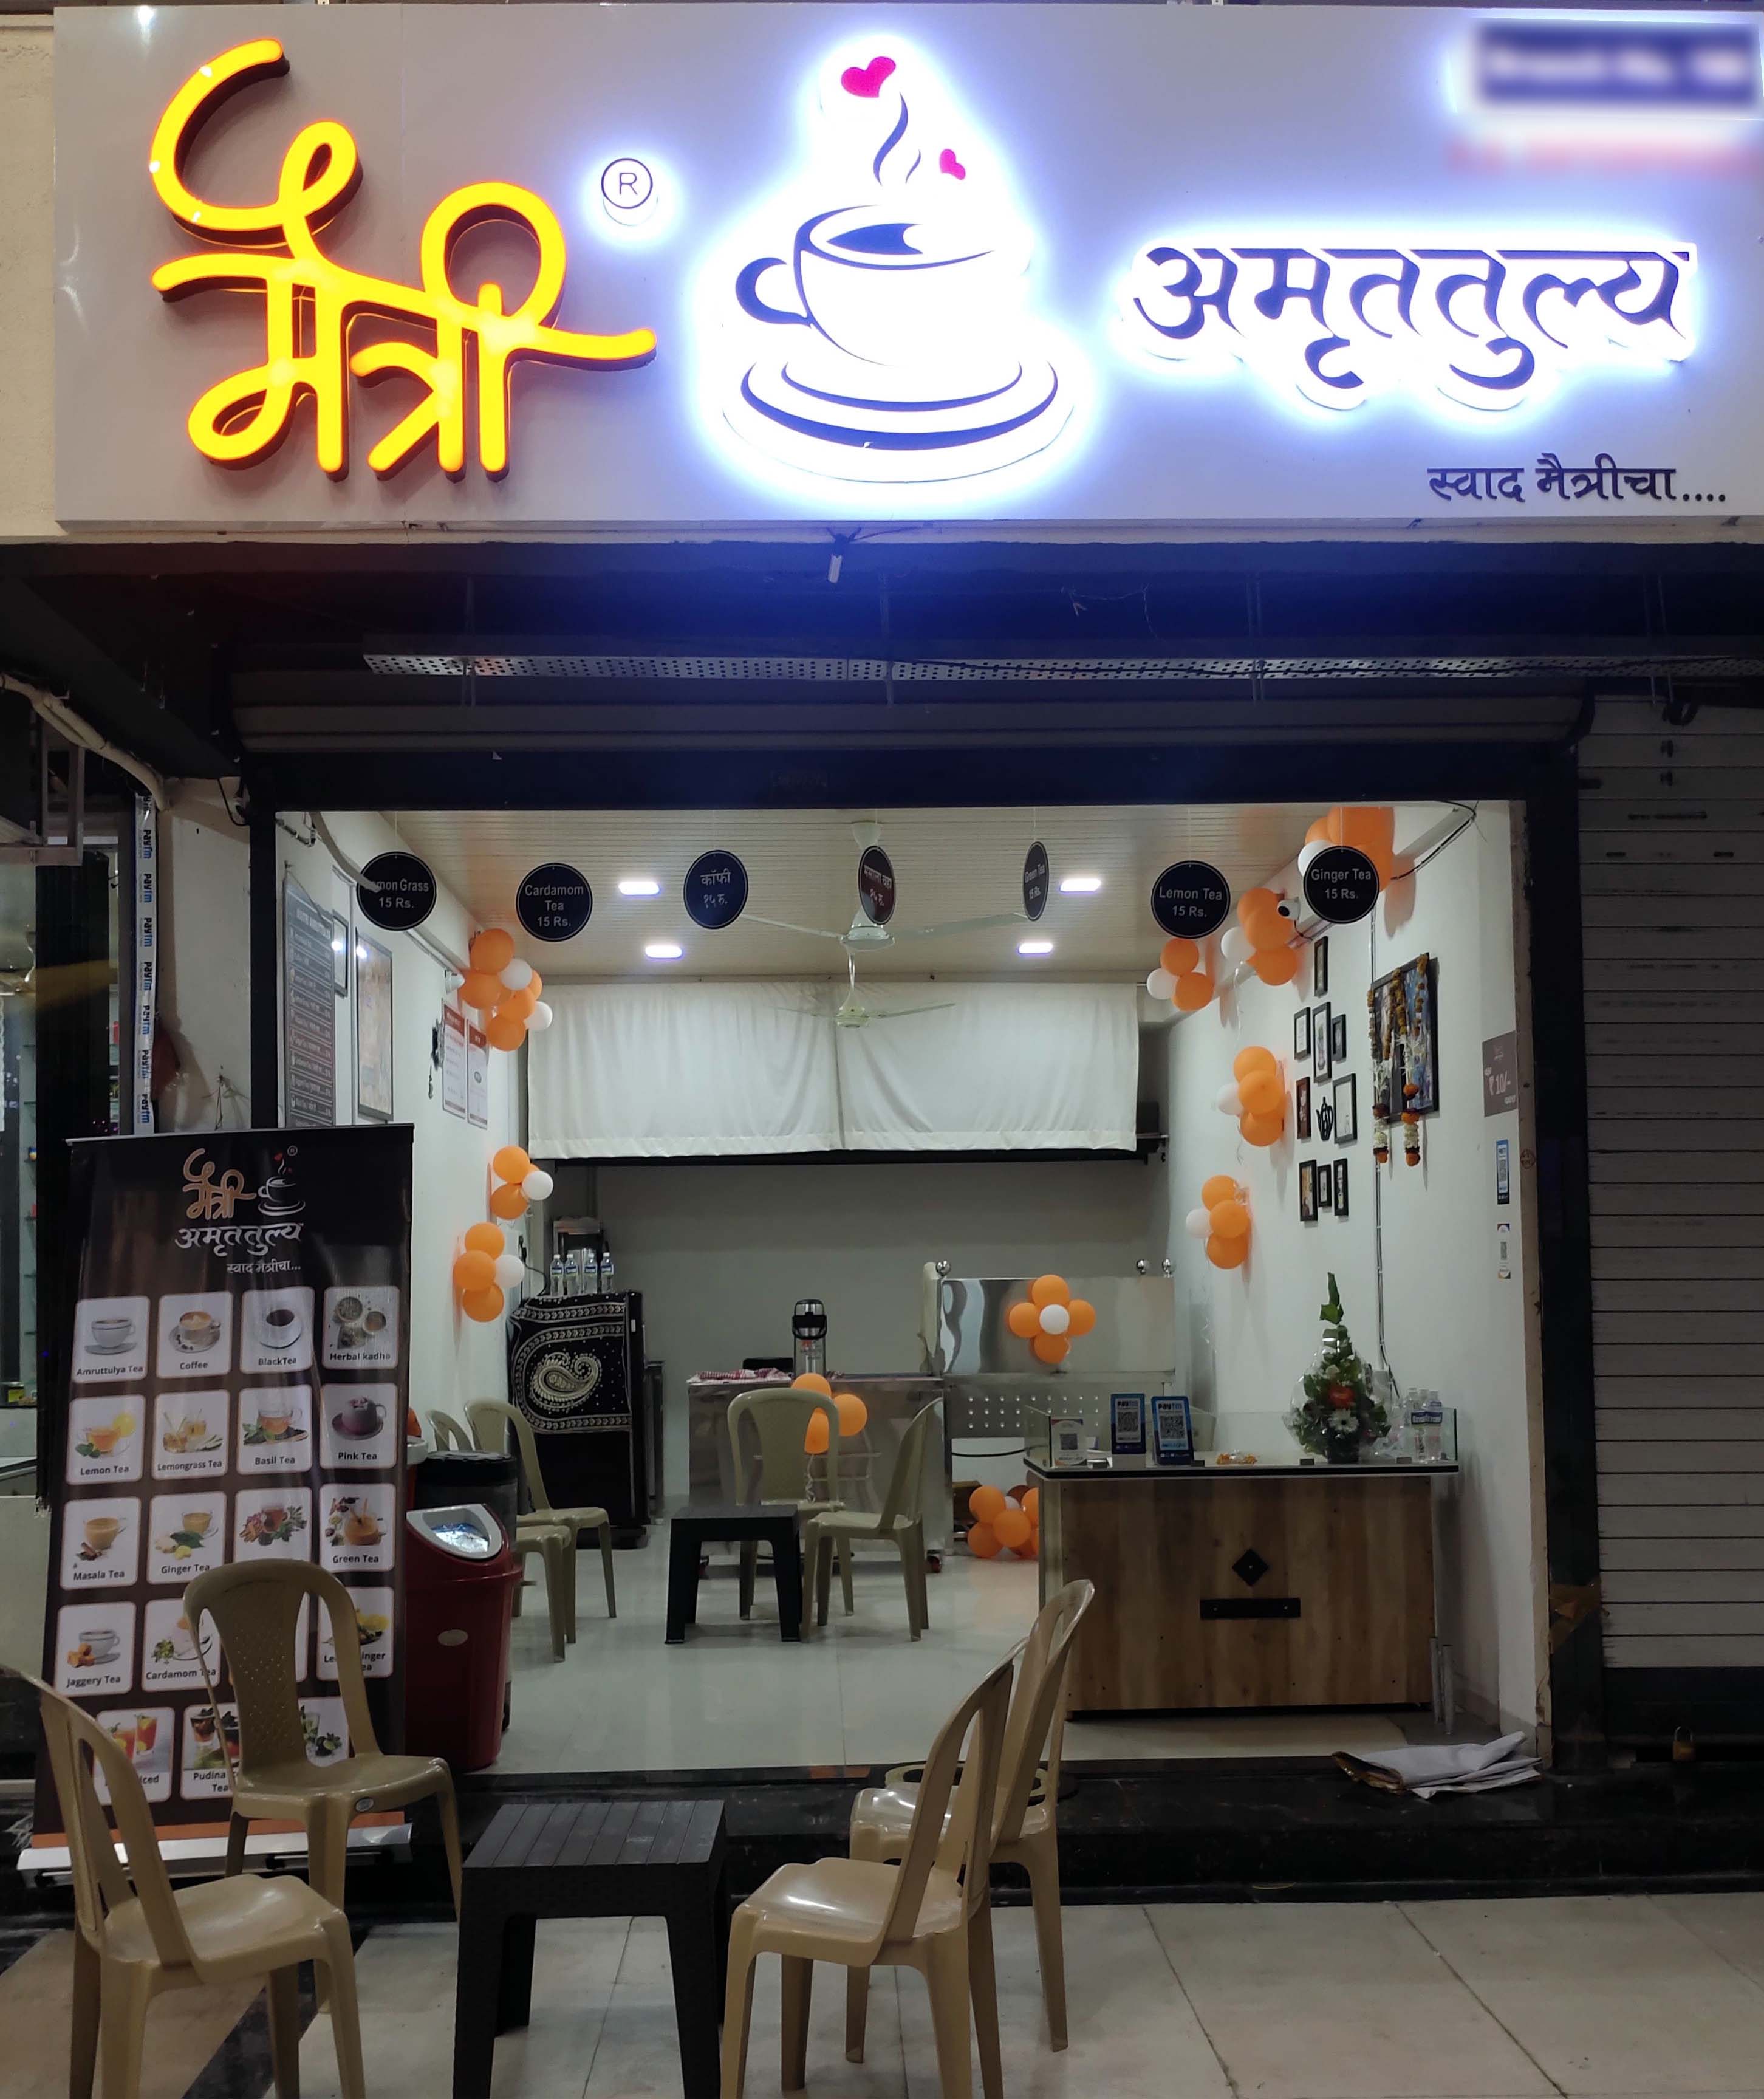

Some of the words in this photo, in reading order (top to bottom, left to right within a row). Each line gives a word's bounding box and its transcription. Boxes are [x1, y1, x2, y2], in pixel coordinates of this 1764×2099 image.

[149, 38, 657, 475] मैत्री
[1134, 247, 1691, 391] अमृततुल्य
[1427, 467, 1525, 502] स्वाद
[700, 868, 731, 885] कॉफी
[1311, 868, 1349, 883] Ginger
[1352, 868, 1371, 880] Tea
[375, 880, 398, 891] mon
[400, 878, 429, 892] Grass
[525, 884, 584, 896] Cardamom
[1159, 886, 1198, 899] Lemon
[1203, 888, 1222, 900] Tea
[1325, 888, 1338, 899] 15
[1341, 888, 1359, 899] Rs.
[379, 897, 392, 908] 15
[395, 897, 414, 908] Rs.
[544, 900, 564, 911] Tea
[703, 894, 716, 909] १५
[1172, 905, 1185, 916] 15
[1189, 906, 1208, 917] Rs.
[538, 916, 550, 927] 15
[553, 916, 571, 927] Rs.
[174, 1222, 304, 1256] अमृततुल्य
[227, 1263, 254, 1274] स्वाद
[330, 1352, 360, 1361] Herbal
[77, 1366, 126, 1376] Amruttulya
[179, 1361, 208, 1370] Coffee
[338, 1452, 358, 1460] Pink
[80, 1467, 111, 1476] Lemon
[157, 1462, 206, 1472] Lemongrass
[161, 1565, 191, 1575] Ginger
[74, 1571, 106, 1581] Masala
[362, 1651, 386, 1662] inger
[146, 1670, 197, 1680] Cardamom
[66, 1677, 101, 1687] Jaggery
[193, 1771, 226, 1781] Pudina
